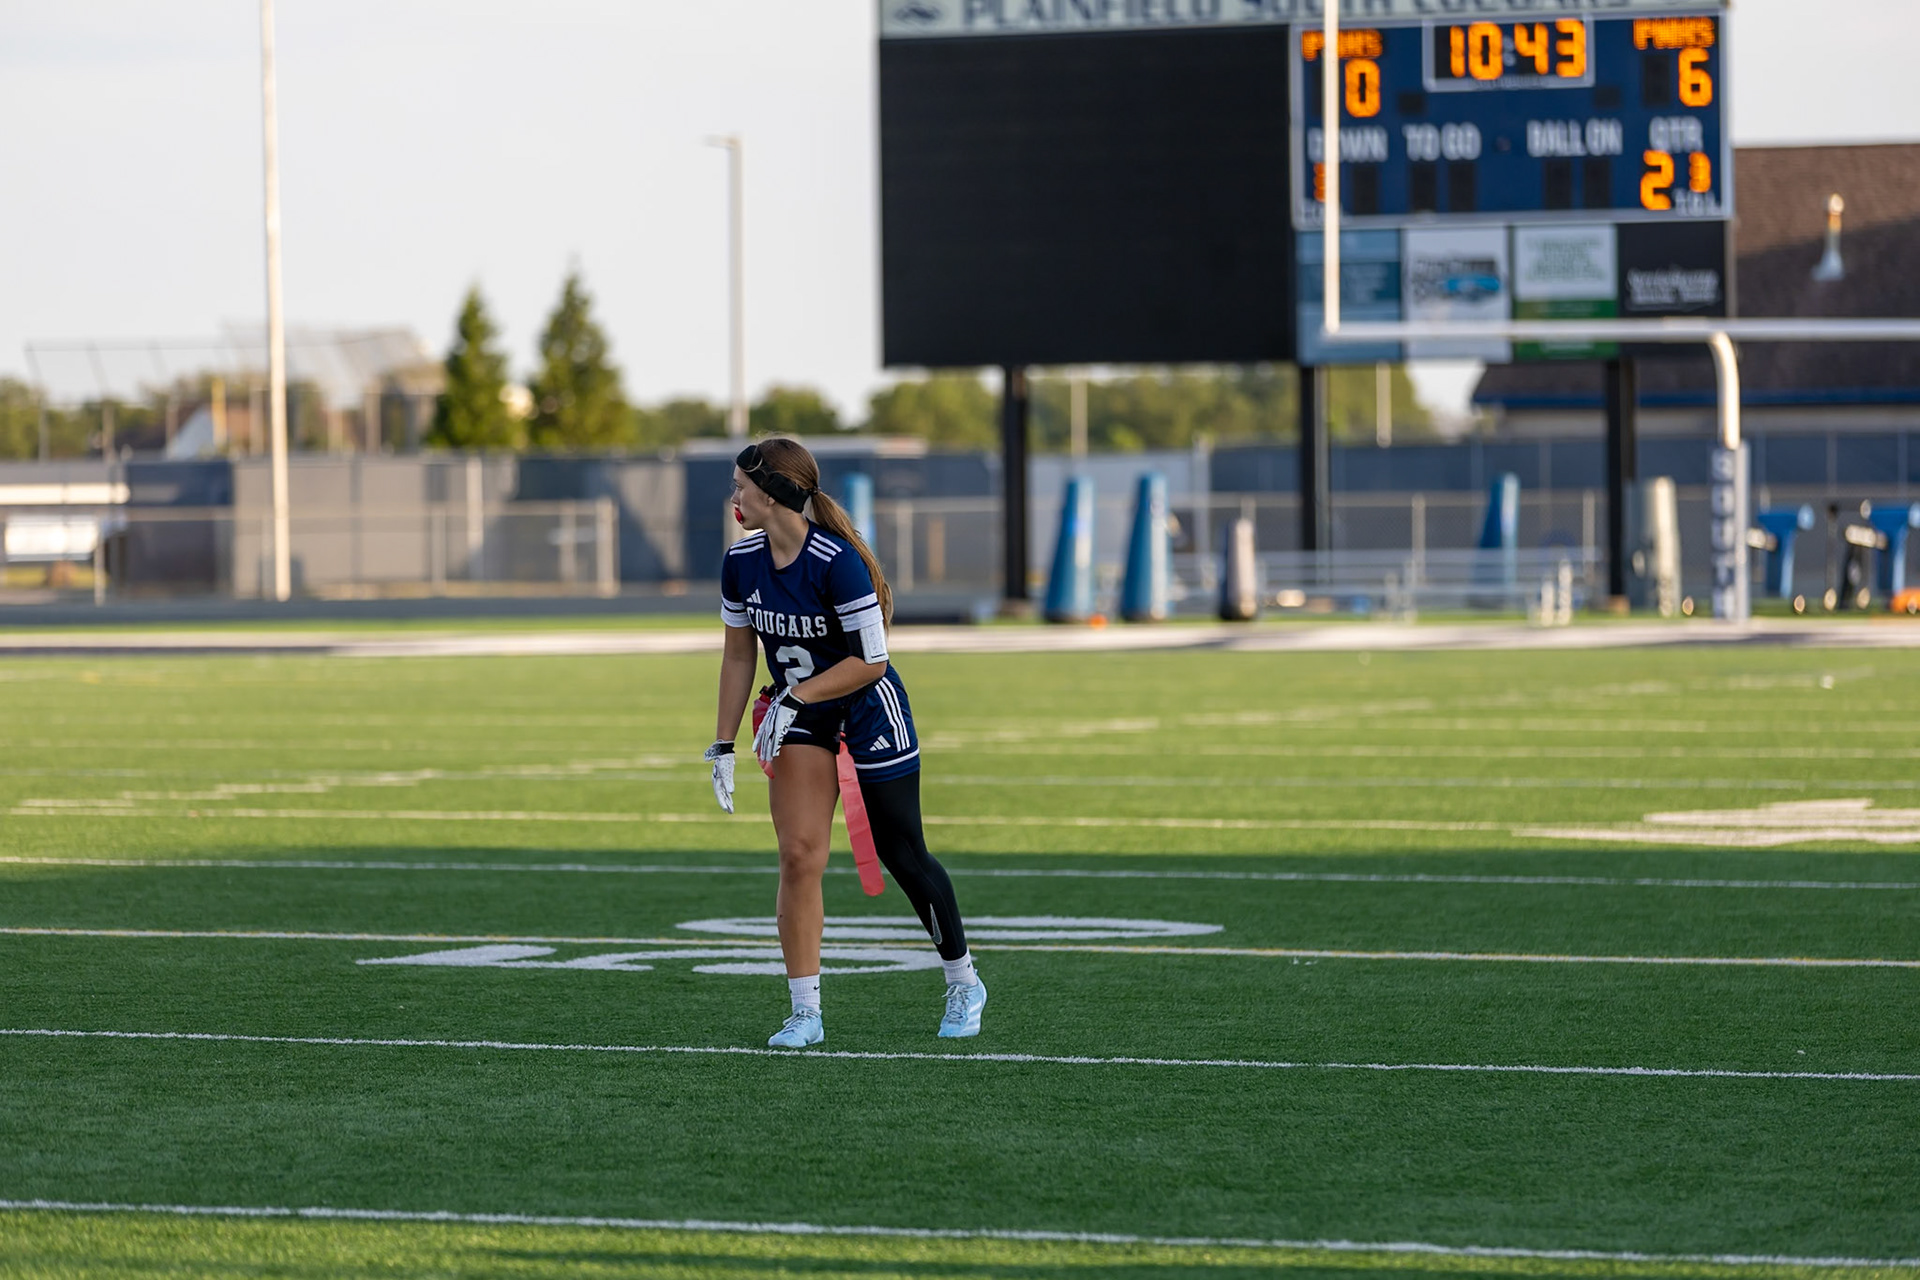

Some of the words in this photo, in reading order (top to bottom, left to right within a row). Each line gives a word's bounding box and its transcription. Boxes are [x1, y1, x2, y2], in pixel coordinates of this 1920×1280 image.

[1450, 18, 1586, 80] 10:43
[1679, 48, 1713, 107] 6
[1345, 59, 1380, 117] 0
[1640, 149, 1674, 210] 2
[746, 606, 828, 638] COUGARS
[775, 645, 815, 686] 2
